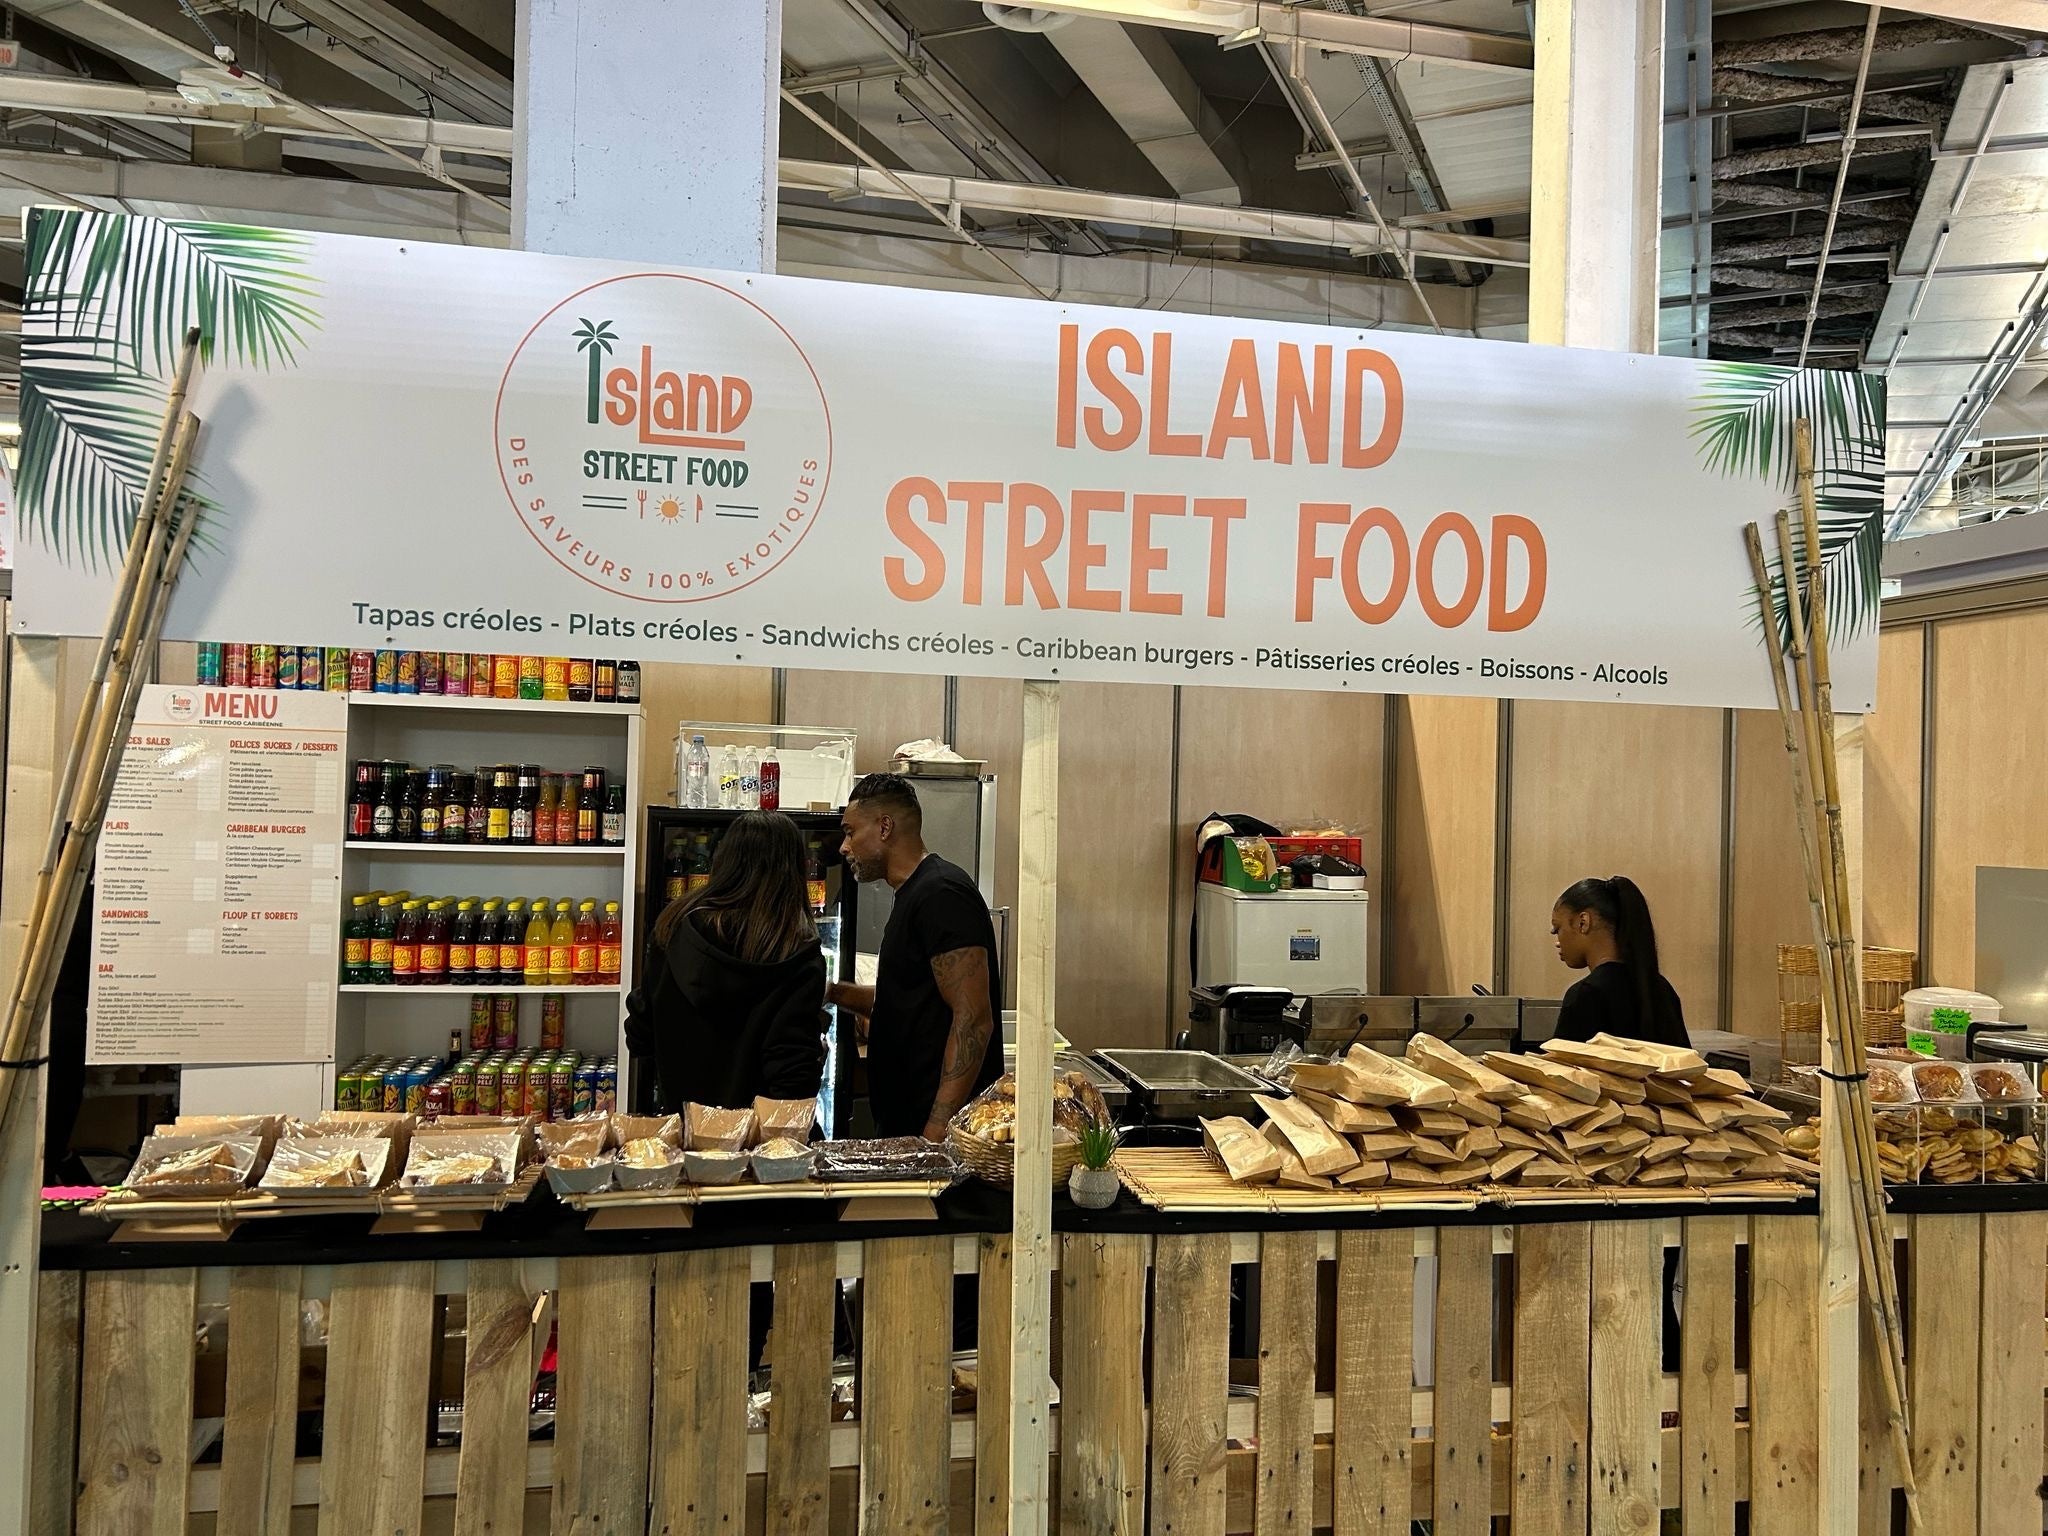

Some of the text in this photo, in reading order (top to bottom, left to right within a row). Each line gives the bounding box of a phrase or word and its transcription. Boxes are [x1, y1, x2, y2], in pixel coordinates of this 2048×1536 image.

[1056, 324, 1404, 469] ISLAND
[583, 449, 749, 489] STREET FOOD
[509, 437, 818, 589] DES SAVEURS 100% EXOTIQUES
[884, 476, 1548, 633] STREET FOOD
[352, 602, 435, 631] Tapas
[443, 607, 543, 633] créoles
[569, 613, 636, 638] Plats
[643, 617, 738, 643] créoles
[762, 623, 900, 651] Sandwichs
[907, 631, 994, 655] créoles
[1016, 637, 1137, 662] Caribbean
[1145, 641, 1234, 670] burgers
[1255, 647, 1375, 672] Pâtisseries
[1381, 653, 1460, 676] créoles
[1480, 657, 1574, 681] Boissons
[1593, 663, 1668, 686] Alcools
[205, 692, 278, 719] MENU
[146, 736, 171, 746] SALES
[229, 740, 260, 749] DELICES
[263, 741, 292, 750] SUCRES
[302, 743, 338, 752] DESSERTS
[105, 821, 129, 830] PLATS
[226, 824, 306, 834] CARIBBEAN BURGERS
[101, 910, 149, 919] SANDWICHS
[222, 911, 298, 920] FLOUP ET SORBETS
[98, 964, 114, 972] BAR
